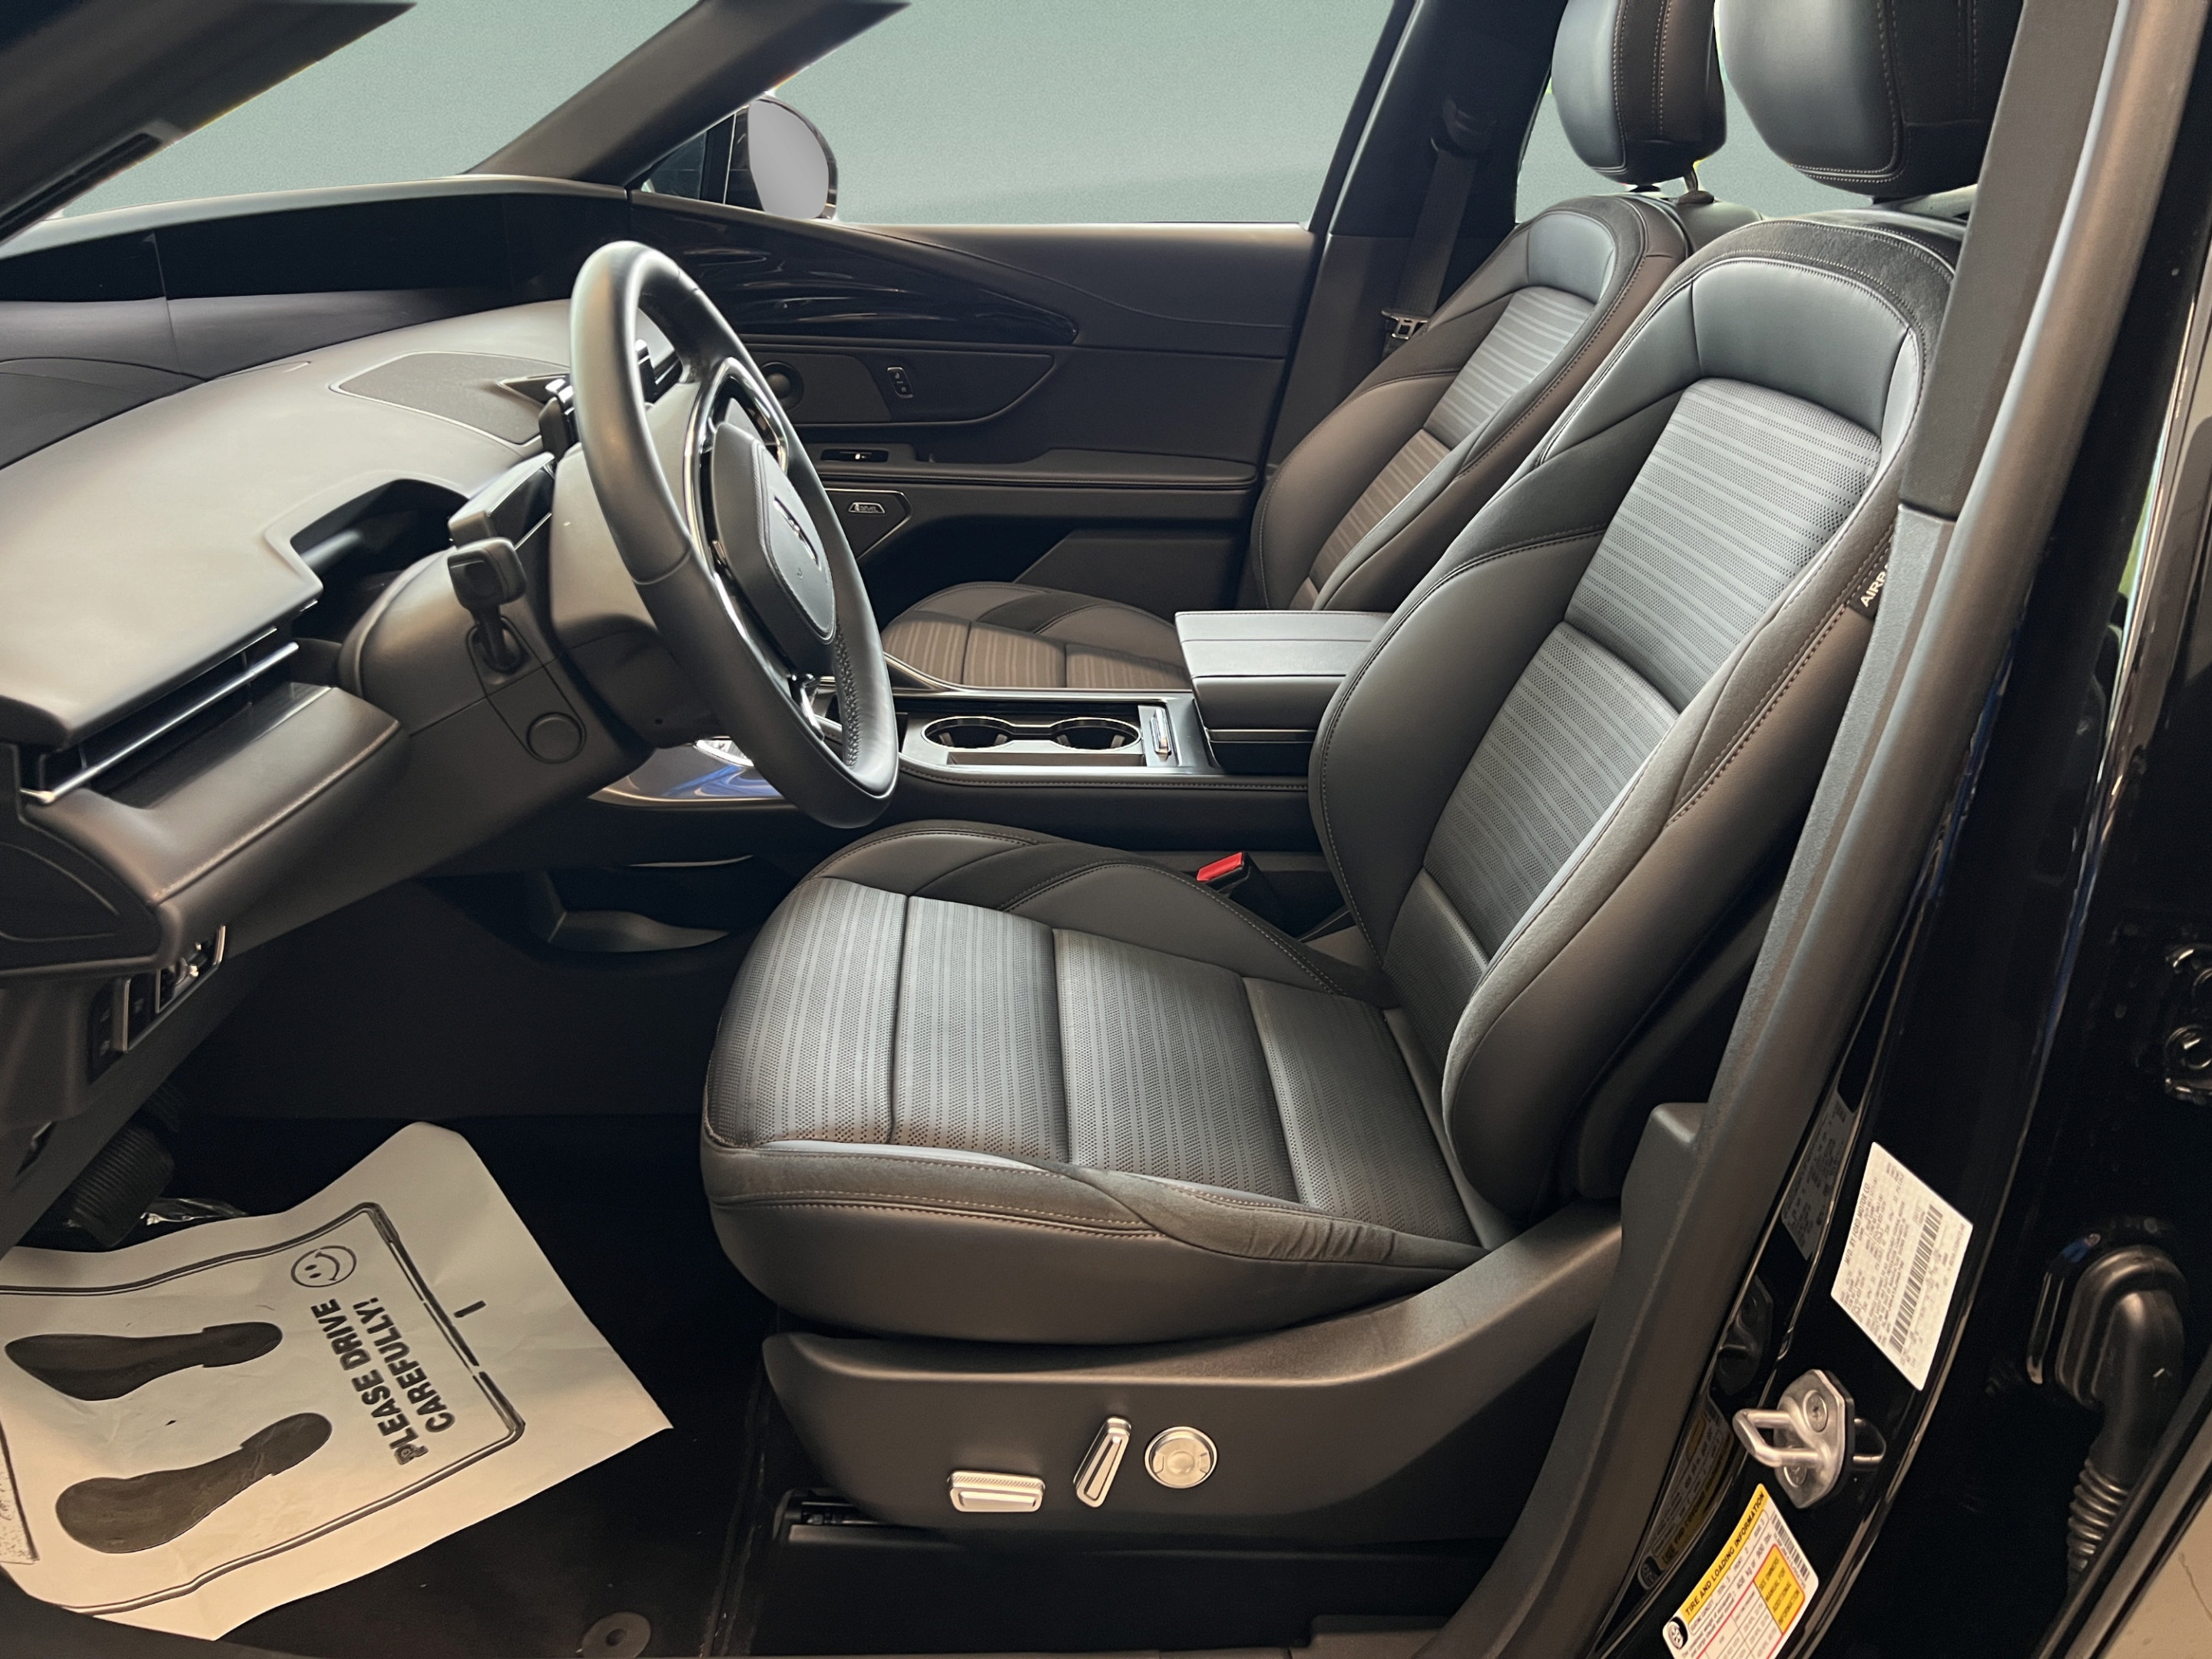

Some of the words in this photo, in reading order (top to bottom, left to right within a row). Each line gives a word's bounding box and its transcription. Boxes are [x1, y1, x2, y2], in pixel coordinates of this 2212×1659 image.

[1850, 1217, 1861, 1237] FORD
[1856, 1193, 1867, 1218] MOTOR
[1848, 1237, 1856, 1247] BY
[310, 1298, 372, 1371] DRIVE
[353, 1297, 455, 1432] CAREFULLY!
[351, 1369, 429, 1465] PLEASE
[1685, 1597, 1700, 1616] TIRE
[1700, 1581, 1712, 1598] AND
[1711, 1547, 1735, 1581] LOADING
[1735, 1492, 1765, 1548] INFORMATION
[1744, 1565, 1753, 1576] kg
[1750, 1558, 1757, 1568] or
